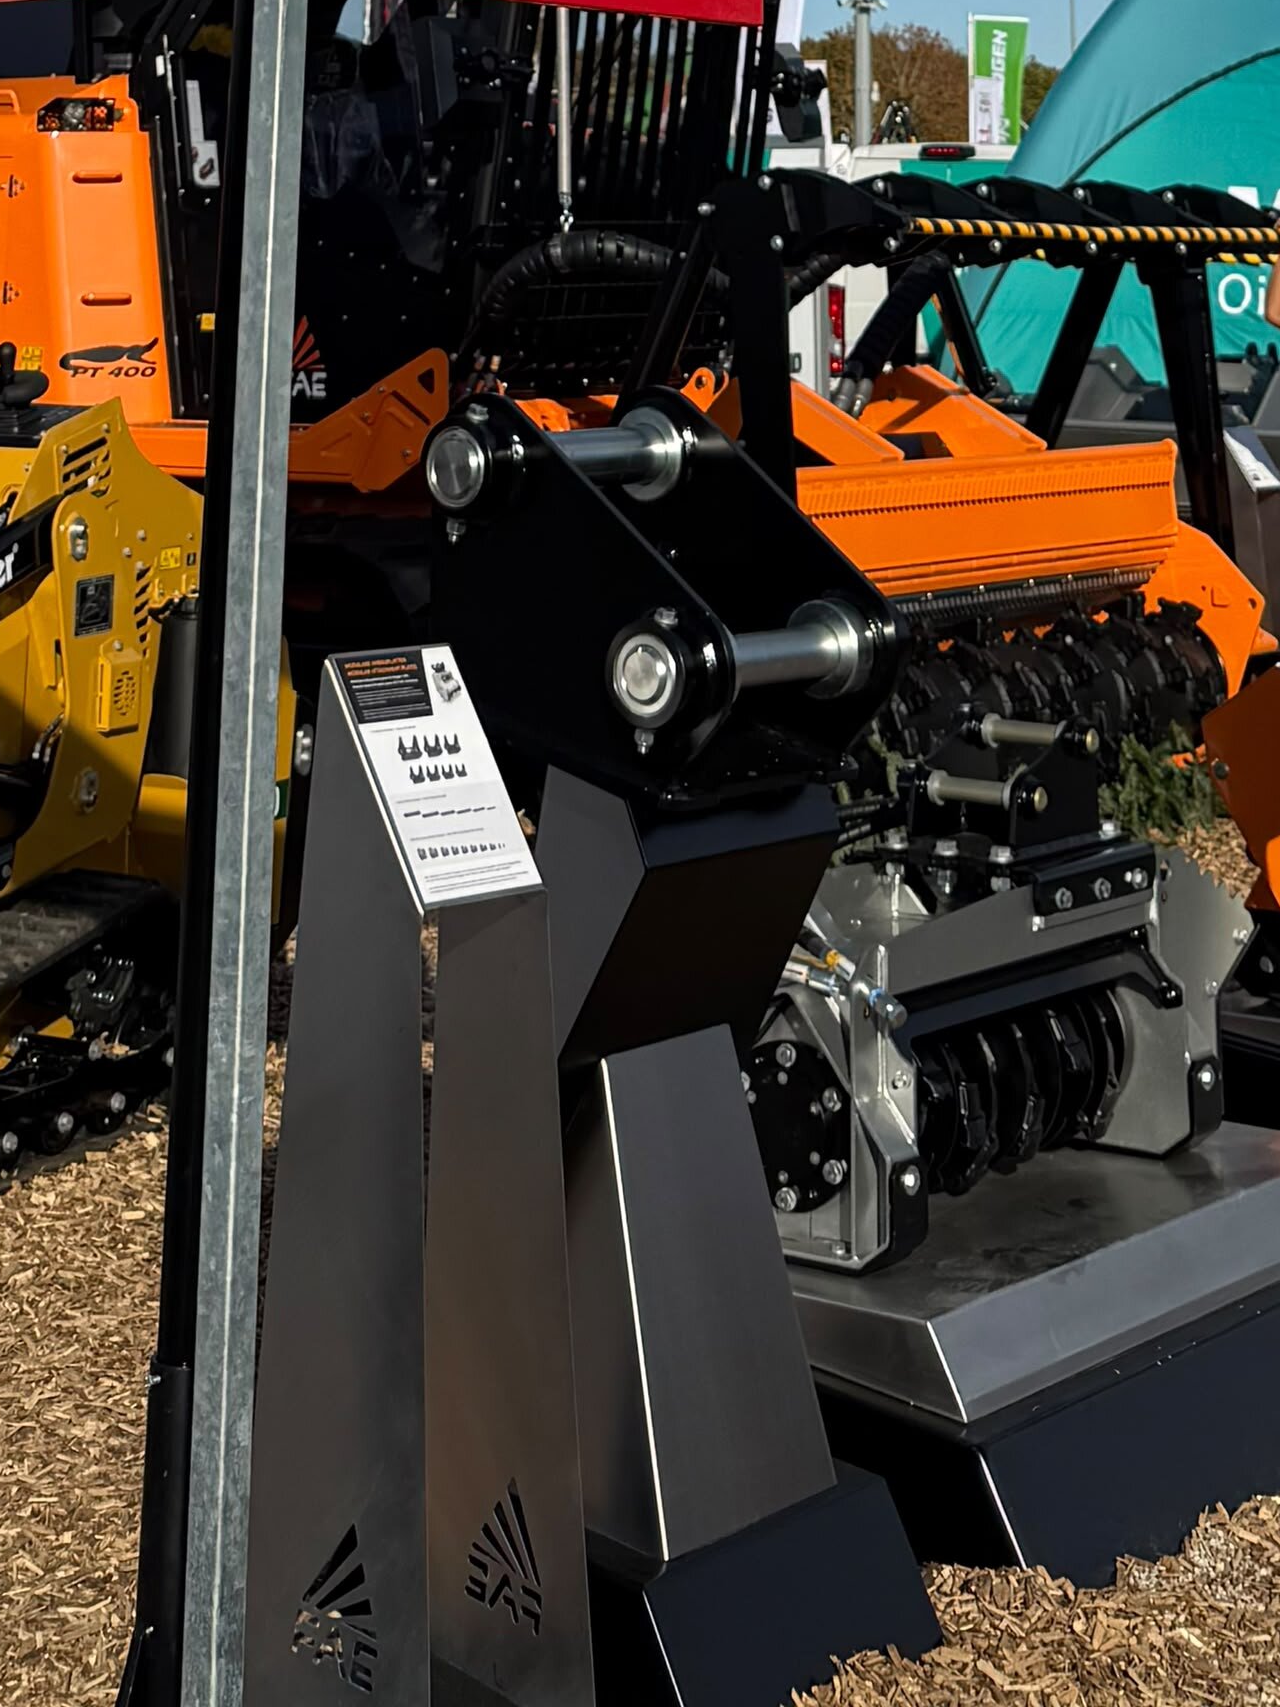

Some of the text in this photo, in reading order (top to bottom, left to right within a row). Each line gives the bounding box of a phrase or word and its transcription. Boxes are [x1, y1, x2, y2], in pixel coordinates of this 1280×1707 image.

[1218, 273, 1267, 316] Oi
[70, 365, 157, 378] PT 400
[292, 372, 327, 398] AE
